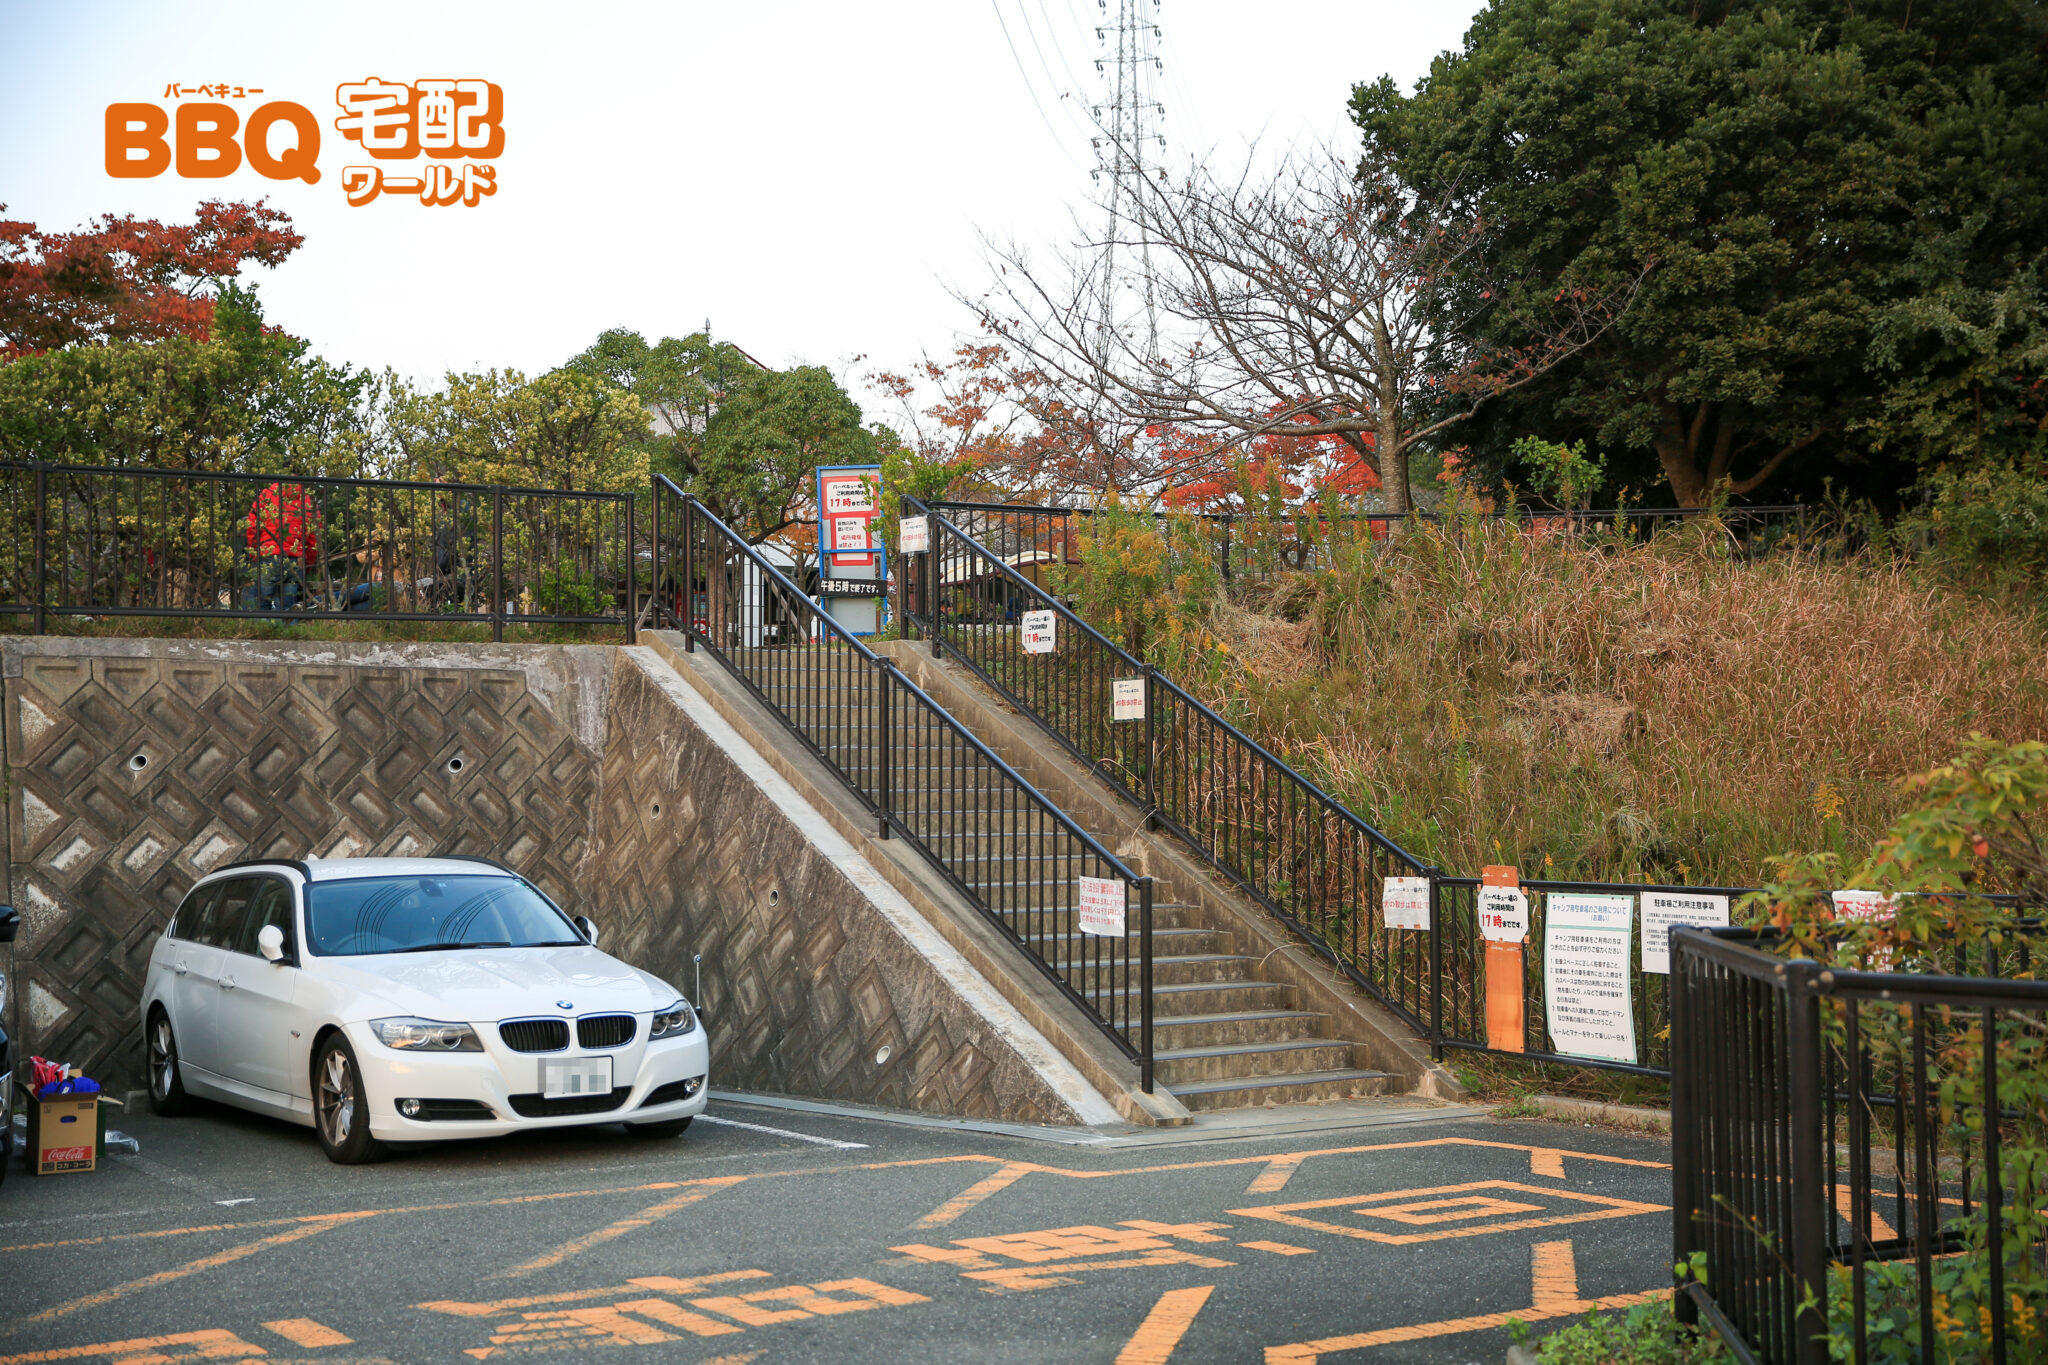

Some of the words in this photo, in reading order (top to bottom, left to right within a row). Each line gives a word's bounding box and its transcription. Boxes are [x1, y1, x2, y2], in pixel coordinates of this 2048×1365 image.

[820, 580, 879, 593] 午後5時で終了です。
[1484, 894, 1518, 902] バーベキュー場の
[1487, 903, 1515, 911] ご利用時間は
[1552, 904, 1627, 914] キャンプ用駐車場のご利用について
[1654, 899, 1715, 911] 駐車場ご利用注意事項
[1482, 914, 1523, 929] 17時までです。
